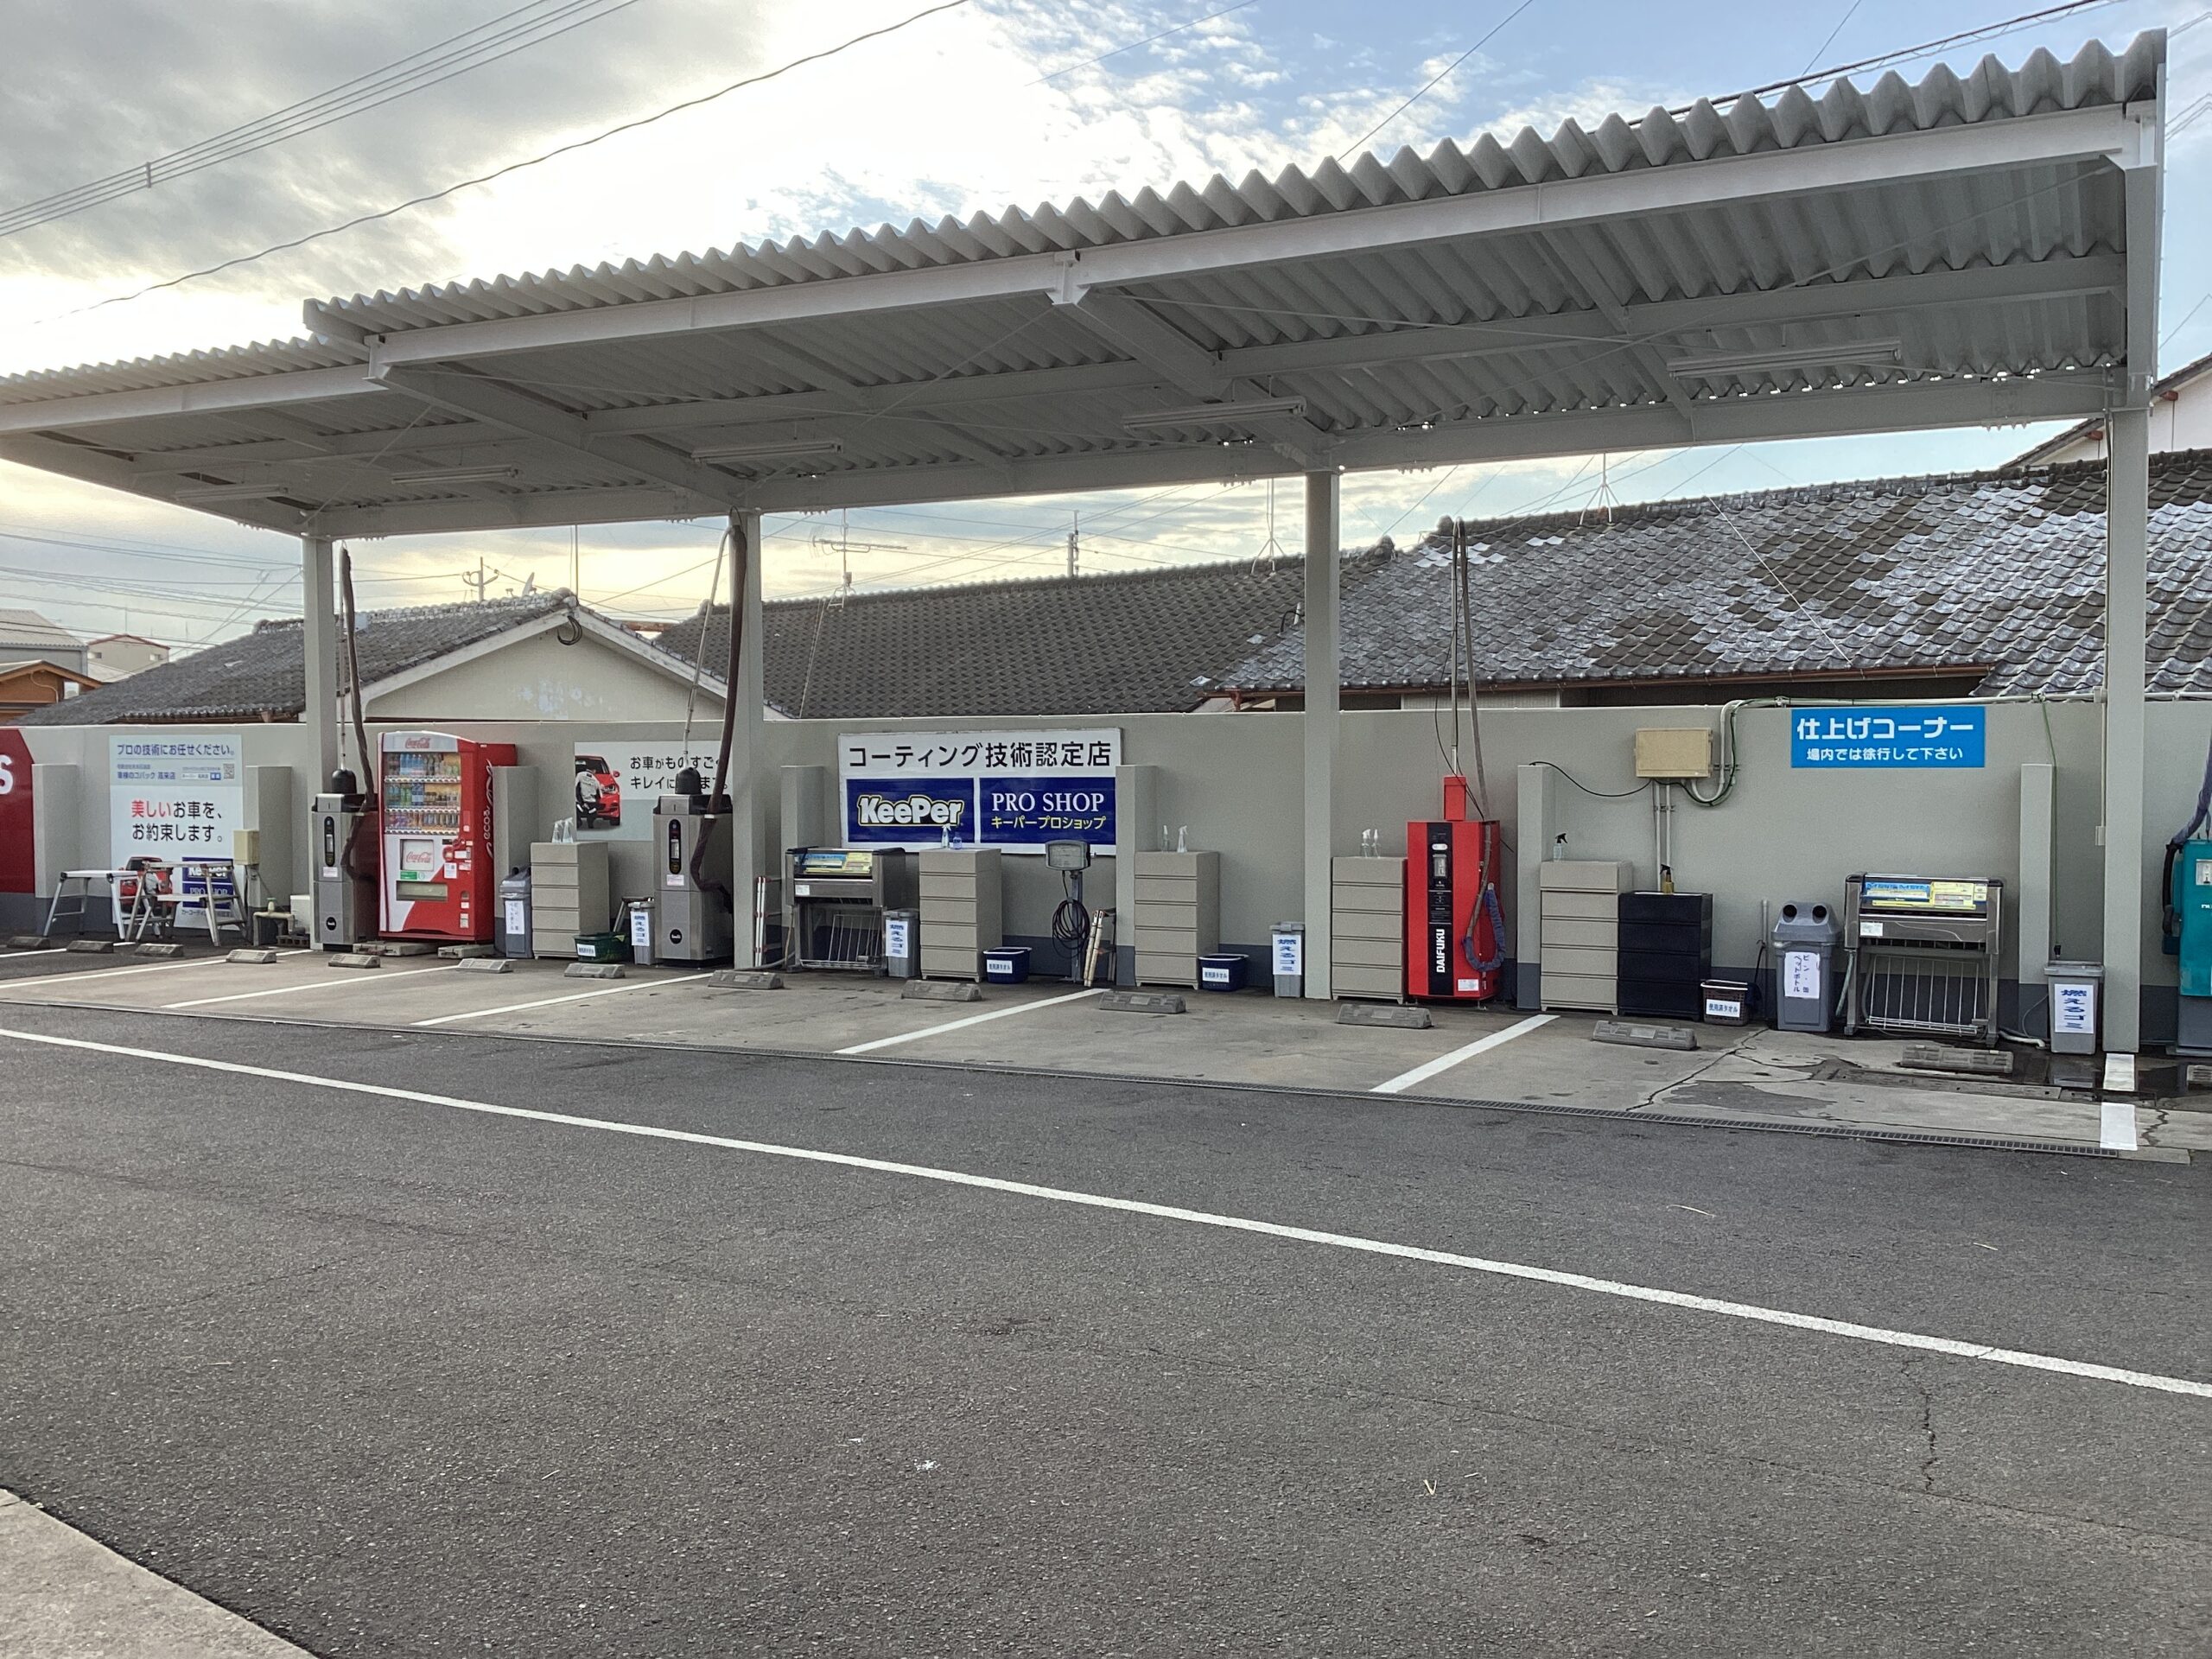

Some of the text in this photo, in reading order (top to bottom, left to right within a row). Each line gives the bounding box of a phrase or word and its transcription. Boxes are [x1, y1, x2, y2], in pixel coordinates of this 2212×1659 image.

[1797, 716, 1974, 741] 仕上げコーナー
[117, 743, 235, 756] プロの技術にお任せください。
[849, 741, 1112, 768] コーティング技術認定店
[1807, 747, 1964, 761] 場内では徐行して下さい
[630, 755, 721, 770] お車がものすご
[131, 799, 223, 819] 美しいお車を、
[858, 795, 964, 826] KeePer
[992, 791, 1105, 812] PRO SHOP
[132, 823, 223, 842] お約束します。
[991, 816, 1107, 830] キーパープロショップ
[1436, 929, 1446, 973] DAIFUKU
